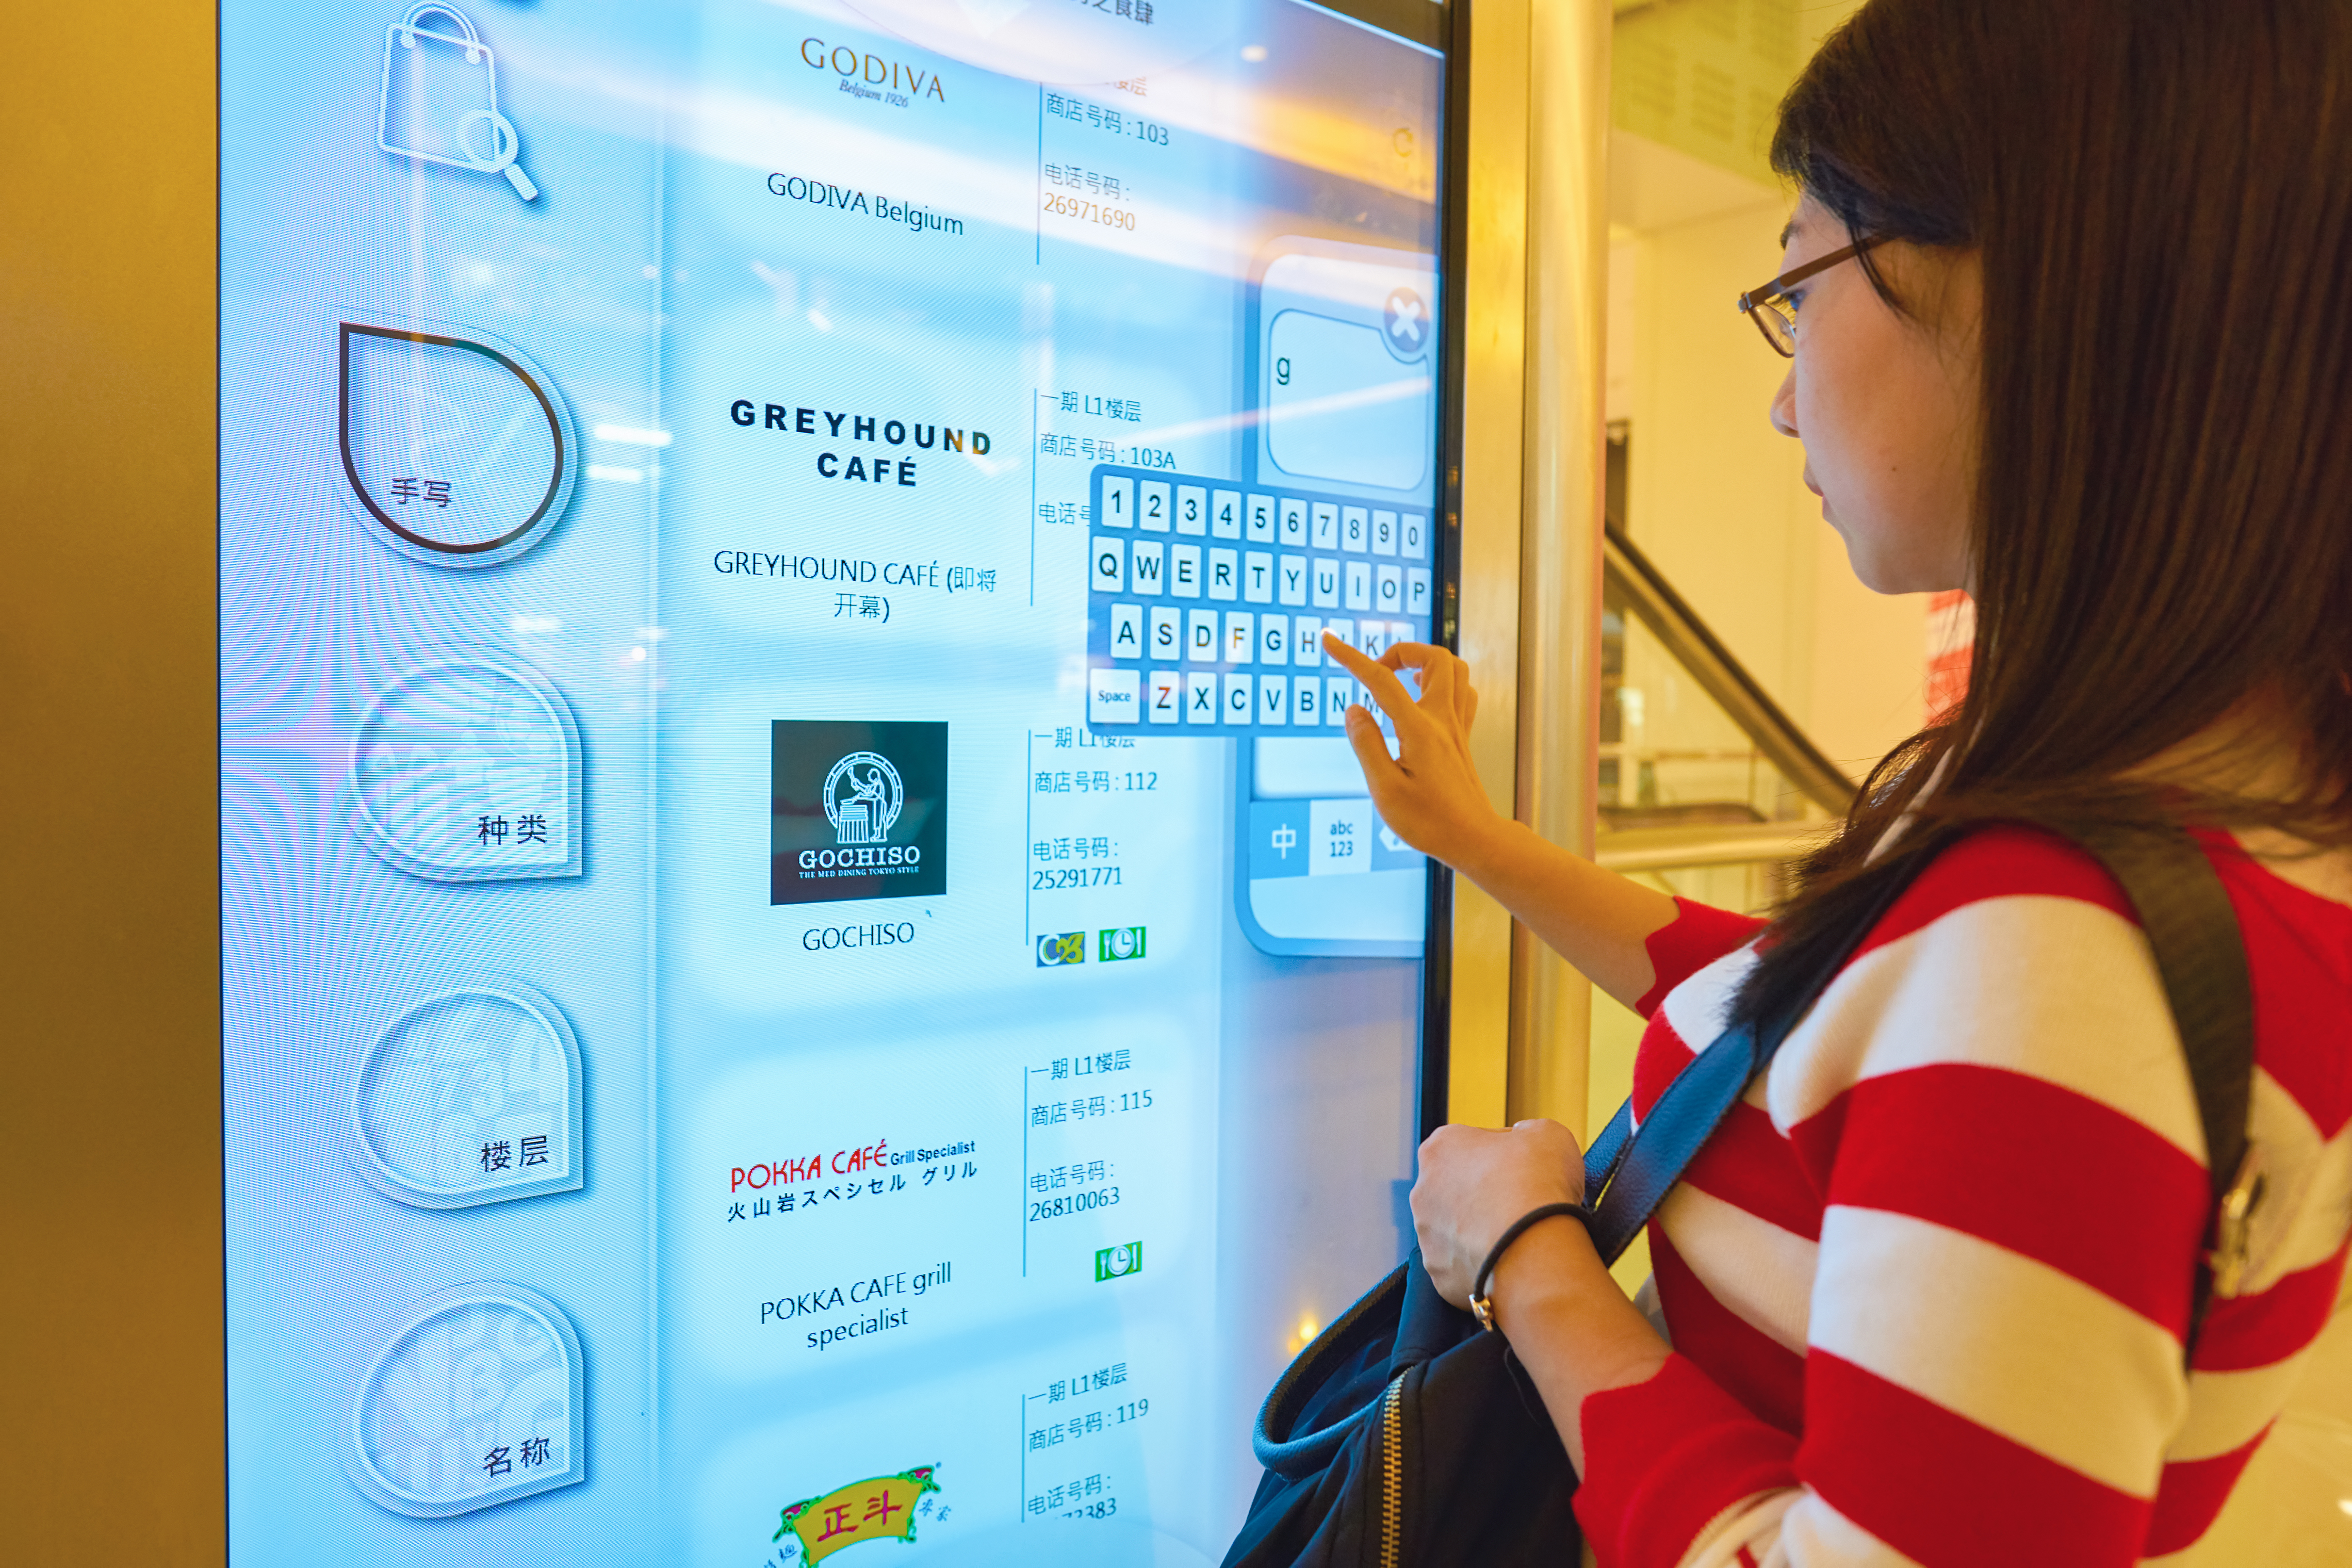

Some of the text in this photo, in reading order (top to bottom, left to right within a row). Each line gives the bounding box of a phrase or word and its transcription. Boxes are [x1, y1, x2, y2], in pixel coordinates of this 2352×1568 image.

[801, 38, 944, 103] GODIVA
[839, 78, 908, 107] Belgium 1926
[767, 172, 963, 235] GODIVA Belgium
[1043, 192, 1135, 232] 26971690
[1277, 357, 1290, 386] g
[730, 399, 991, 455] GREYHOUND
[817, 452, 917, 486] CAFÉ
[390, 478, 451, 508] 手写
[1111, 489, 1418, 546] 1 2 3 4 5 6 7 8 9 0
[714, 550, 876, 583] GREYHOUND
[884, 559, 939, 587] CAFÉ
[1099, 552, 1425, 601] Q W E R T Y U I O P
[1117, 620, 1379, 656] A S D F G H K
[1098, 690, 1131, 703] Space
[1156, 687, 1171, 709] Z
[1194, 688, 1210, 710] X
[1232, 689, 1246, 710] C
[1266, 689, 1281, 711] V
[1301, 691, 1314, 712] B
[1333, 692, 1346, 713] N
[478, 814, 547, 846] 种类
[1271, 823, 1296, 860] 中
[1329, 819, 1354, 836] abc
[798, 845, 921, 869] GOCHISO
[1330, 841, 1354, 858] 123
[838, 869, 867, 877] DINING
[868, 867, 895, 876] TOKYO
[896, 866, 920, 874] STYLE
[1032, 866, 1122, 891] 25291771
[803, 922, 914, 951] GOCHISO
[480, 1134, 549, 1172] 楼层
[731, 1138, 975, 1194] POKKA CAFÉ Grill Specialist
[1029, 1186, 1120, 1222] 26810063
[761, 1261, 951, 1325] POKKA CAFE grill
[807, 1307, 909, 1351] specialist
[483, 1437, 550, 1478] 名称
[817, 1489, 903, 1543] 正斗
